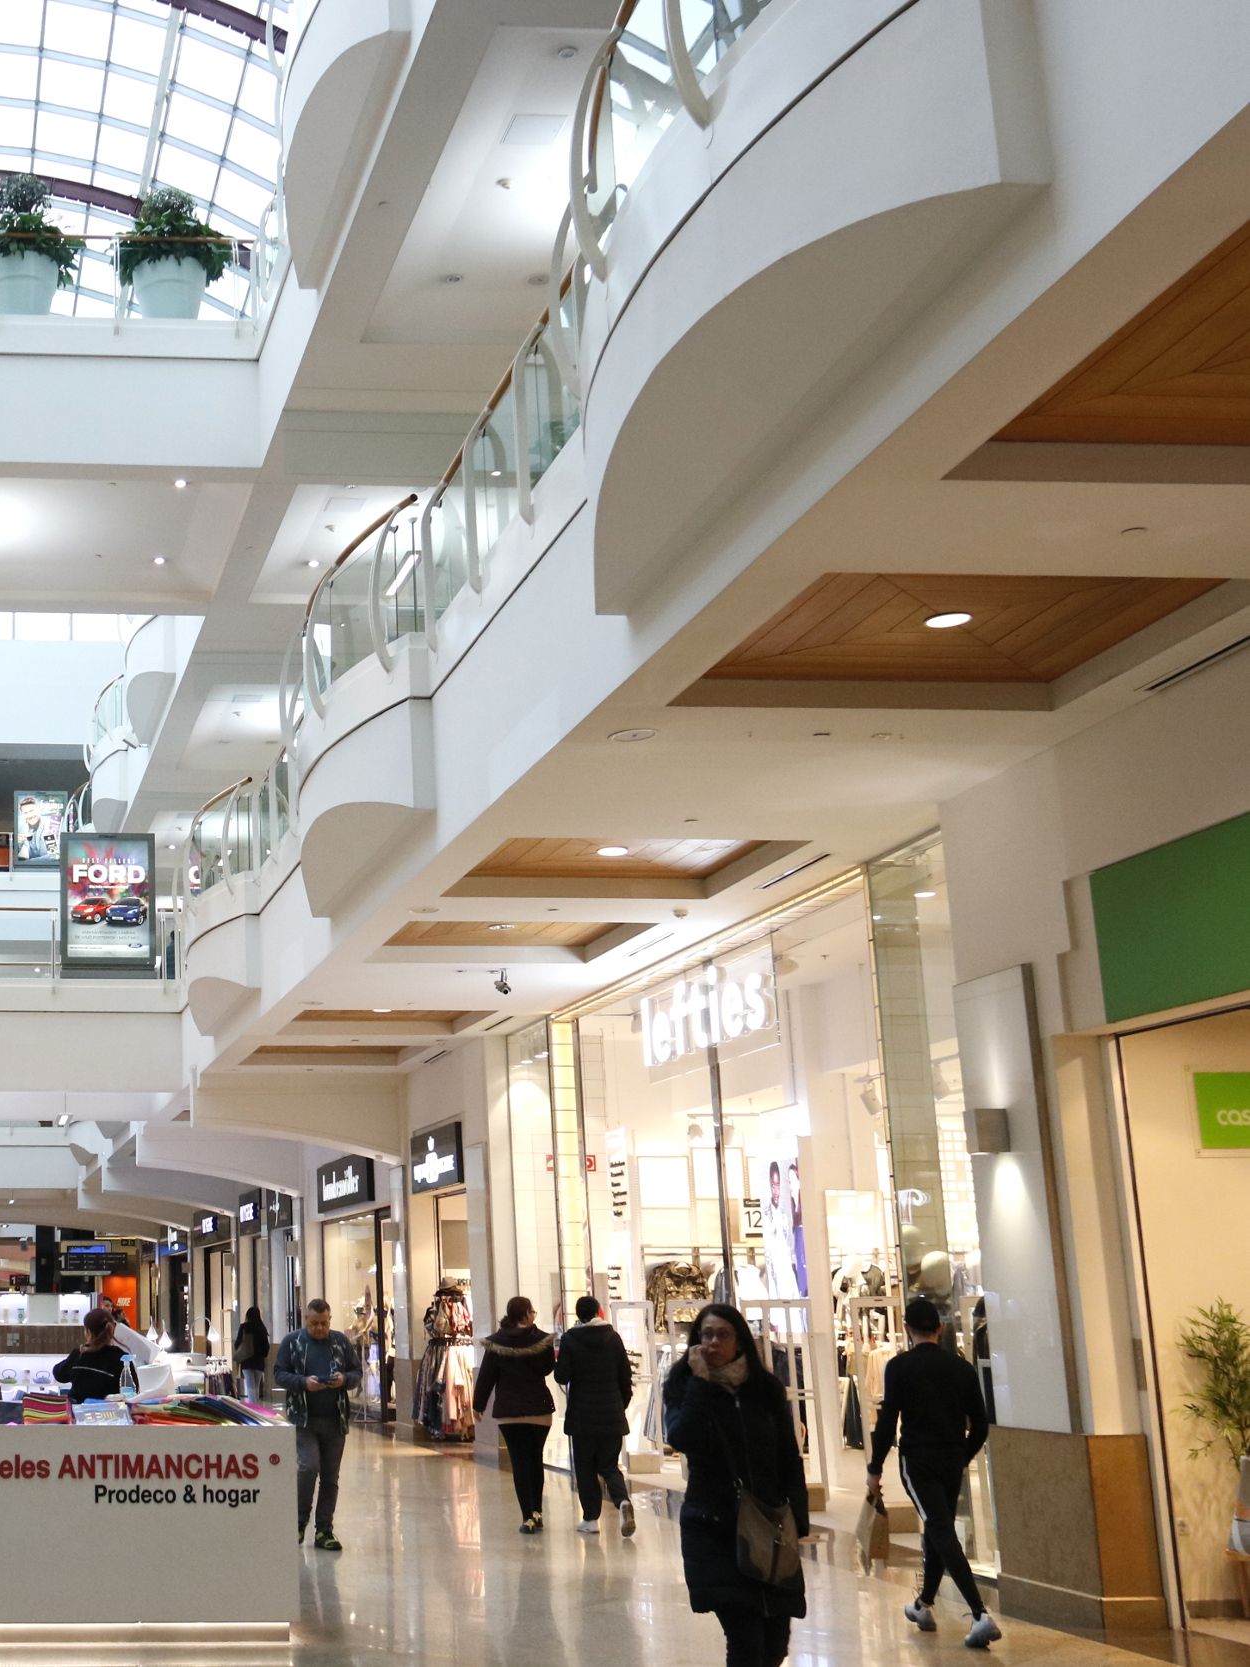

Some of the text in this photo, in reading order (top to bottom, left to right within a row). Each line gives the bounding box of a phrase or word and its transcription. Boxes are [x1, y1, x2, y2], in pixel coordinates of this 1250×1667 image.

[72, 864, 146, 884] FORD
[640, 965, 766, 1067] lefties
[744, 1210, 763, 1228] 12
[58, 1254, 66, 1269] 1
[58, 1453, 260, 1480] ANTIMANCHAS
[94, 1484, 261, 1508] Prodeco & hogar
